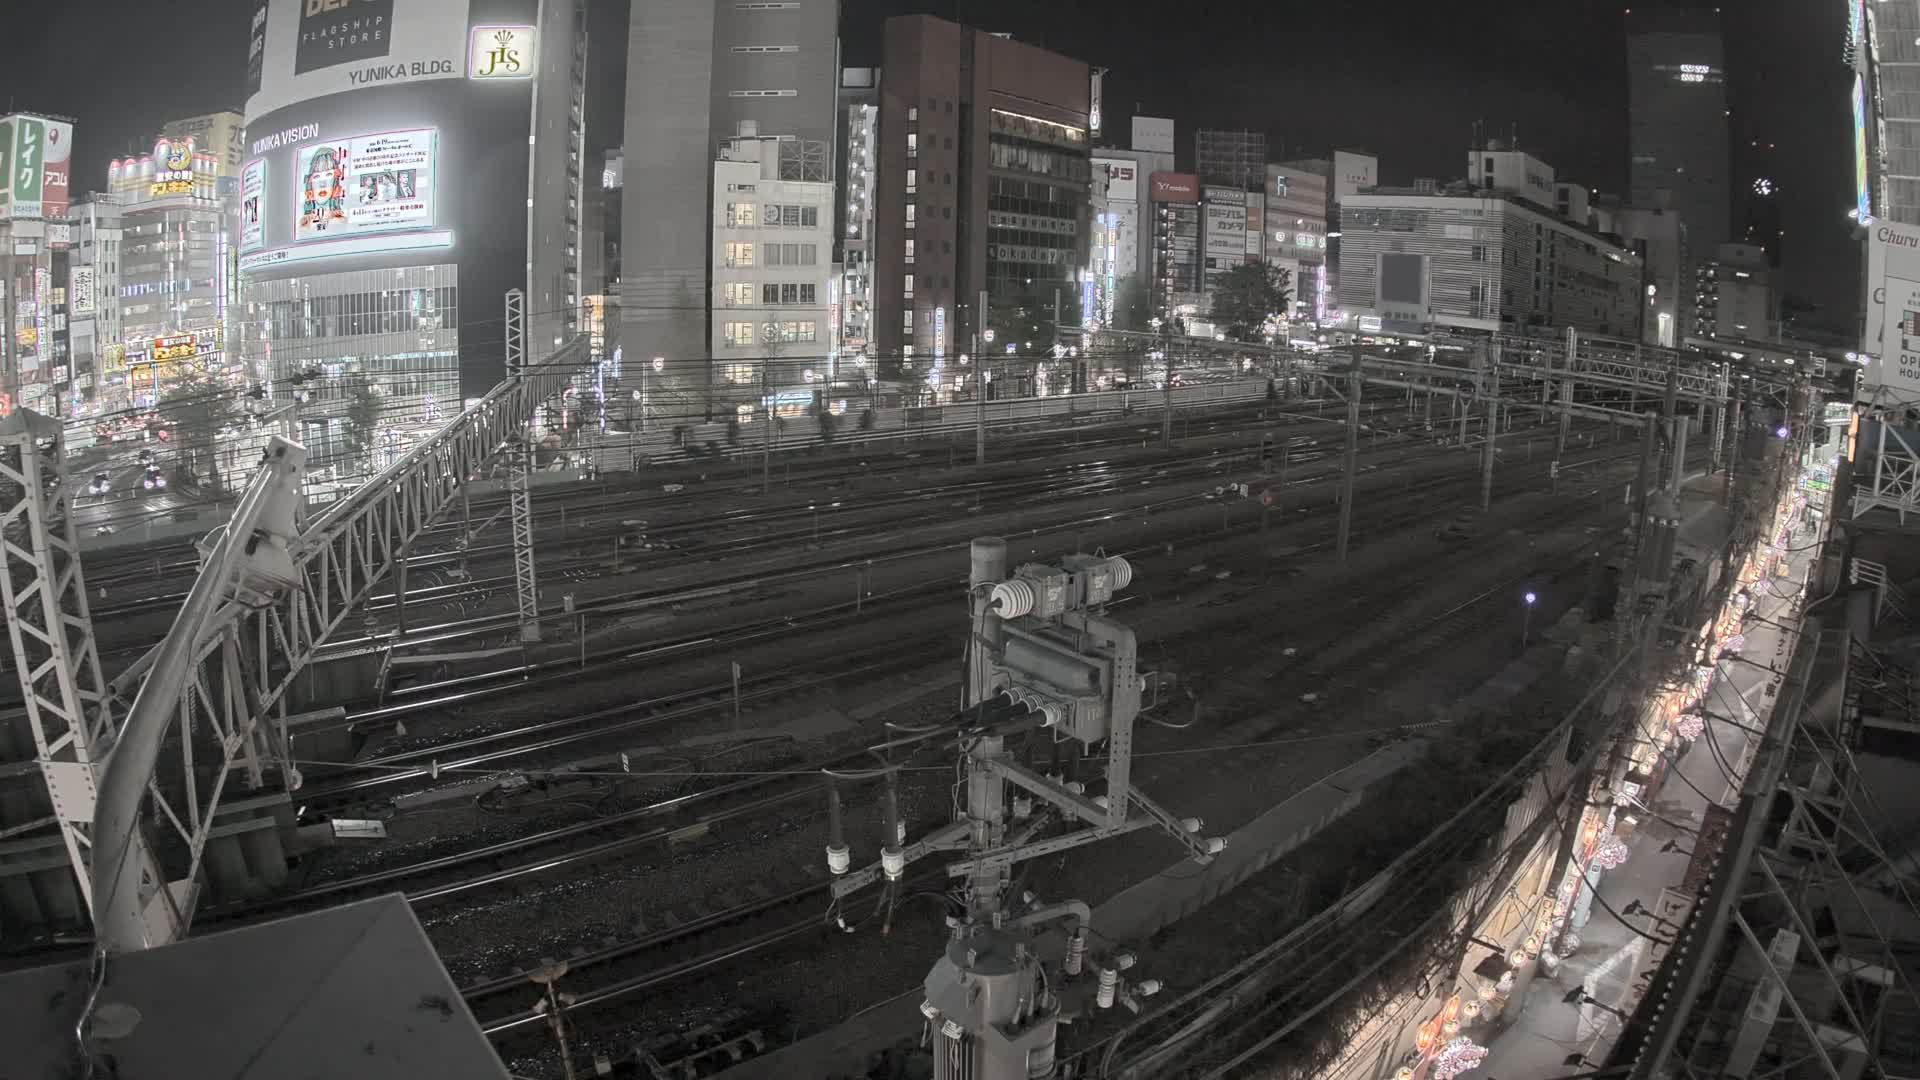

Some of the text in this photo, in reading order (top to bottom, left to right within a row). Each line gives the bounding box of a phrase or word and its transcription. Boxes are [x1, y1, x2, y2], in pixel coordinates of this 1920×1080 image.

[303, 16, 383, 43] FLAGSHIP
[328, 30, 382, 49] STORE
[349, 60, 456, 85] YUNIKA BLDG.
[479, 46, 520, 76] JIS
[253, 134, 280, 156] YUNIKA
[282, 122, 319, 145] VISION
[20, 122, 36, 189] レイク
[45, 171, 67, 186] アコム
[1877, 227, 1919, 248] Churu
